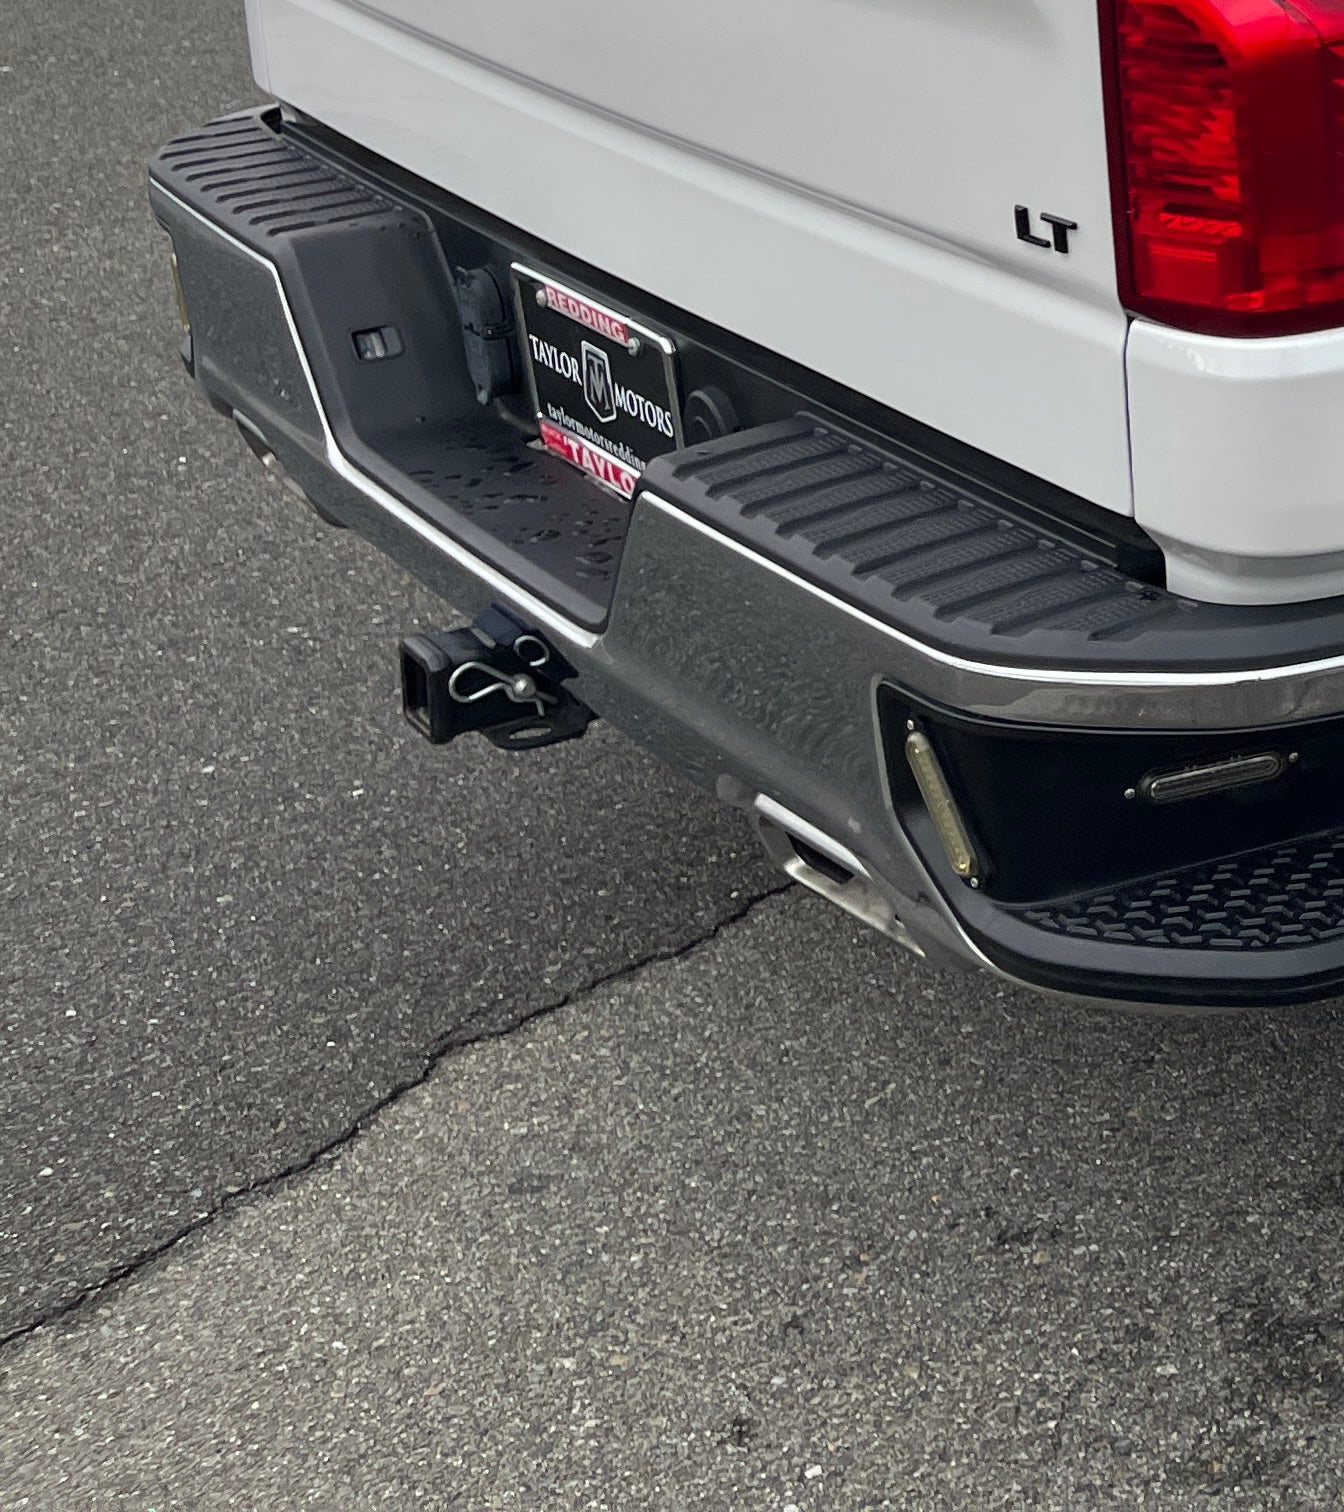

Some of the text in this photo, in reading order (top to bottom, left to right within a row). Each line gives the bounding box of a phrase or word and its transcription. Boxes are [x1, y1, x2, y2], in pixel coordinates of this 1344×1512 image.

[1014, 204, 1078, 254] LT
[546, 286, 626, 341] REDDING
[528, 333, 583, 387] TAYLOR
[614, 382, 674, 438] MOTORS
